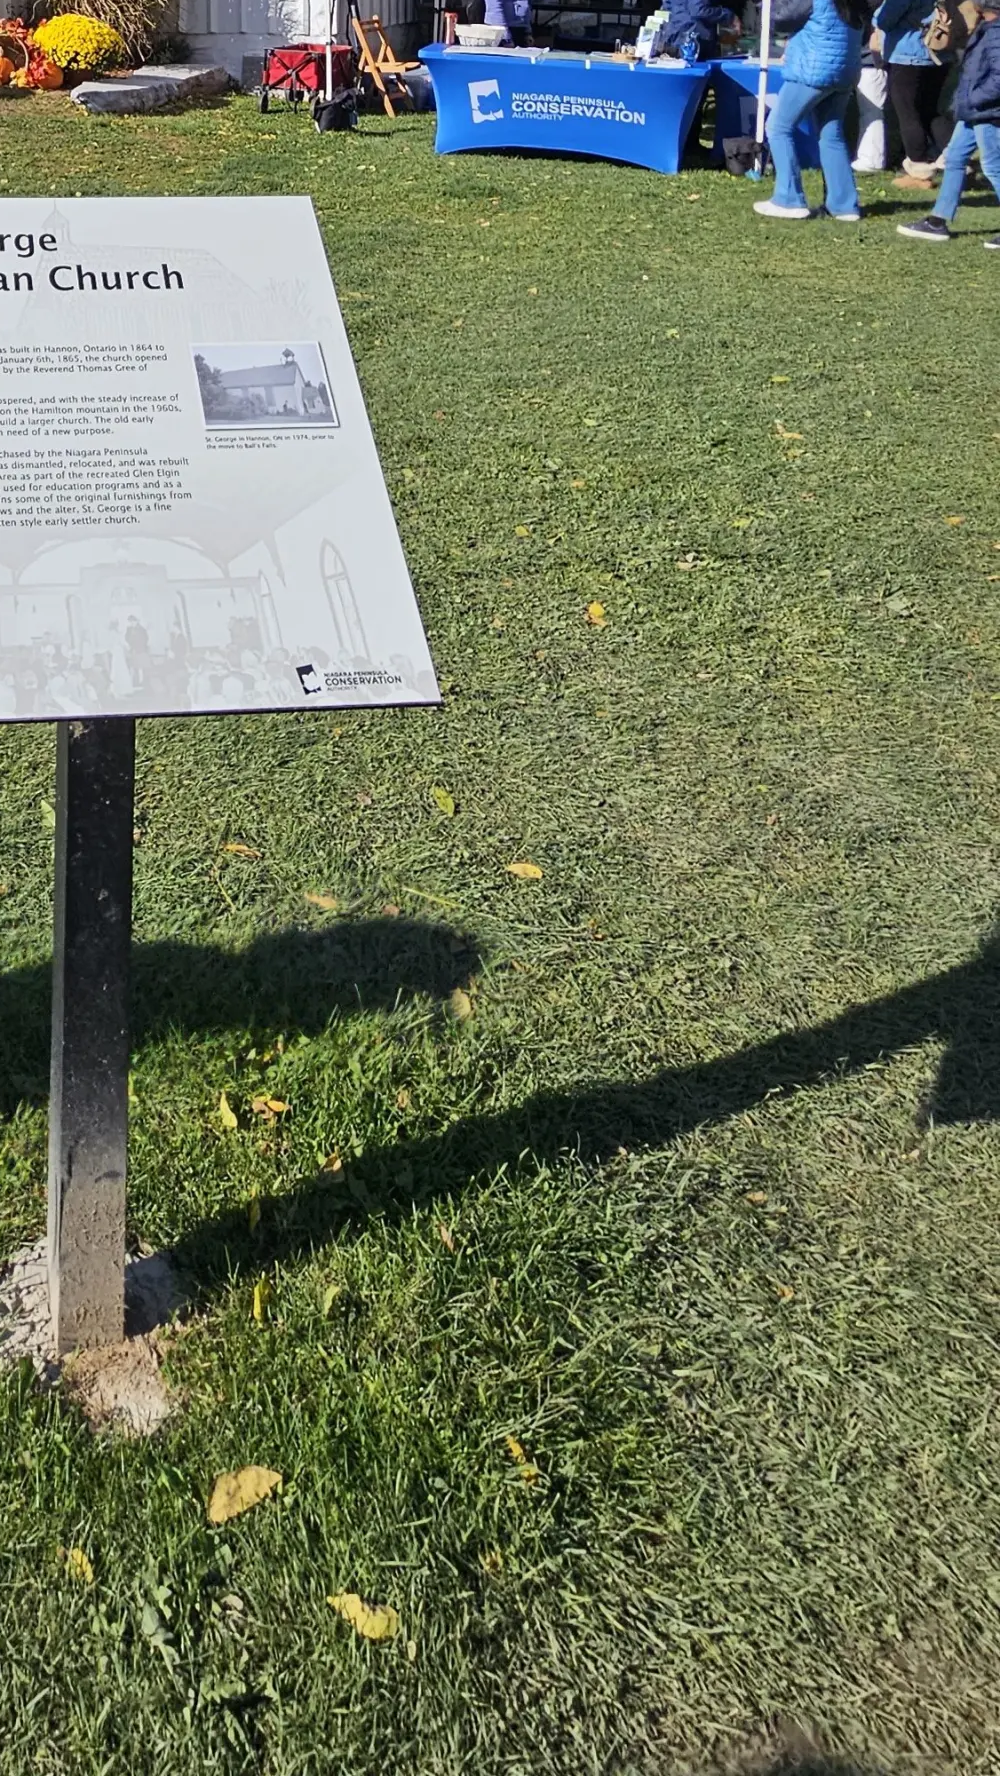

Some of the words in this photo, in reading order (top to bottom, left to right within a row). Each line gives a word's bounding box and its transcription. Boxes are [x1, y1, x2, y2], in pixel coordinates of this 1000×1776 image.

[512, 92, 561, 103] NIAGARA
[562, 95, 626, 110] PENINSULA
[511, 100, 646, 126] CONSERVATION
[511, 111, 564, 122] AUTHORITY
[48, 265, 184, 290] Church
[10, 345, 29, 353] built
[33, 345, 40, 353] in
[44, 344, 80, 354] Hannon,
[83, 344, 116, 352] Ontario
[119, 344, 127, 352] in
[131, 343, 152, 352] 1864
[155, 343, 164, 351] to
[0, 355, 33, 366] January
[36, 354, 53, 364] 6th,
[57, 354, 82, 364] 1865,
[85, 354, 99, 362] the
[102, 353, 132, 362] church
[134, 353, 167, 364] opened
[2, 365, 13, 376] by
[16, 365, 30, 373] the
[33, 365, 74, 373] Reverend
[76, 364, 112, 372] Thomas
[114, 364, 135, 372] Gree
[138, 364, 147, 372] of
[39, 395, 55, 403] and
[58, 395, 78, 403] with
[80, 395, 95, 403] the
[97, 394, 127, 405] steady
[129, 394, 166, 402] increase
[169, 393, 178, 401] of
[13, 406, 29, 414] the
[31, 406, 73, 414] Hamilton
[75, 405, 119, 413] mountain
[121, 405, 130, 413] in
[132, 404, 148, 412] the
[27, 417, 55, 427] larger
[57, 416, 92, 424] church.
[93, 416, 111, 424] The
[113, 415, 129, 423] old
[131, 415, 154, 426] early
[6, 428, 28, 436] need
[31, 427, 41, 435] of
[73, 428, 114, 437] purpose.
[33, 449, 44, 460] by
[47, 449, 62, 457] the
[65, 448, 101, 459] Niagara
[103, 447, 147, 456] Peninsula
[11, 460, 66, 470] dismantled,
[69, 459, 115, 469] relocated,
[118, 458, 135, 467] and
[159, 458, 188, 466] rebuilt
[33, 471, 53, 482] part
[55, 471, 65, 479] of
[67, 471, 83, 479] the
[86, 470, 130, 478] recreated
[132, 469, 154, 477] Glen
[156, 469, 179, 480] Elgin
[2, 483, 25, 491] used
[28, 482, 42, 491] for
[45, 482, 92, 490] education
[94, 483, 139, 492] programs
[142, 480, 160, 488] and
[43, 494, 52, 502] of
[56, 493, 71, 501] the
[74, 493, 110, 504] original
[113, 492, 166, 503] furnishings
[169, 491, 191, 499] from
[15, 505, 33, 514] and
[36, 504, 51, 513] the
[97, 504, 131, 515] George
[134, 503, 142, 511] is
[153, 503, 171, 511] fine
[19, 517, 42, 528] style
[44, 517, 68, 528] early
[71, 516, 101, 524] settler
[104, 515, 140, 524] church.
[325, 675, 402, 686] CONSERVATION
